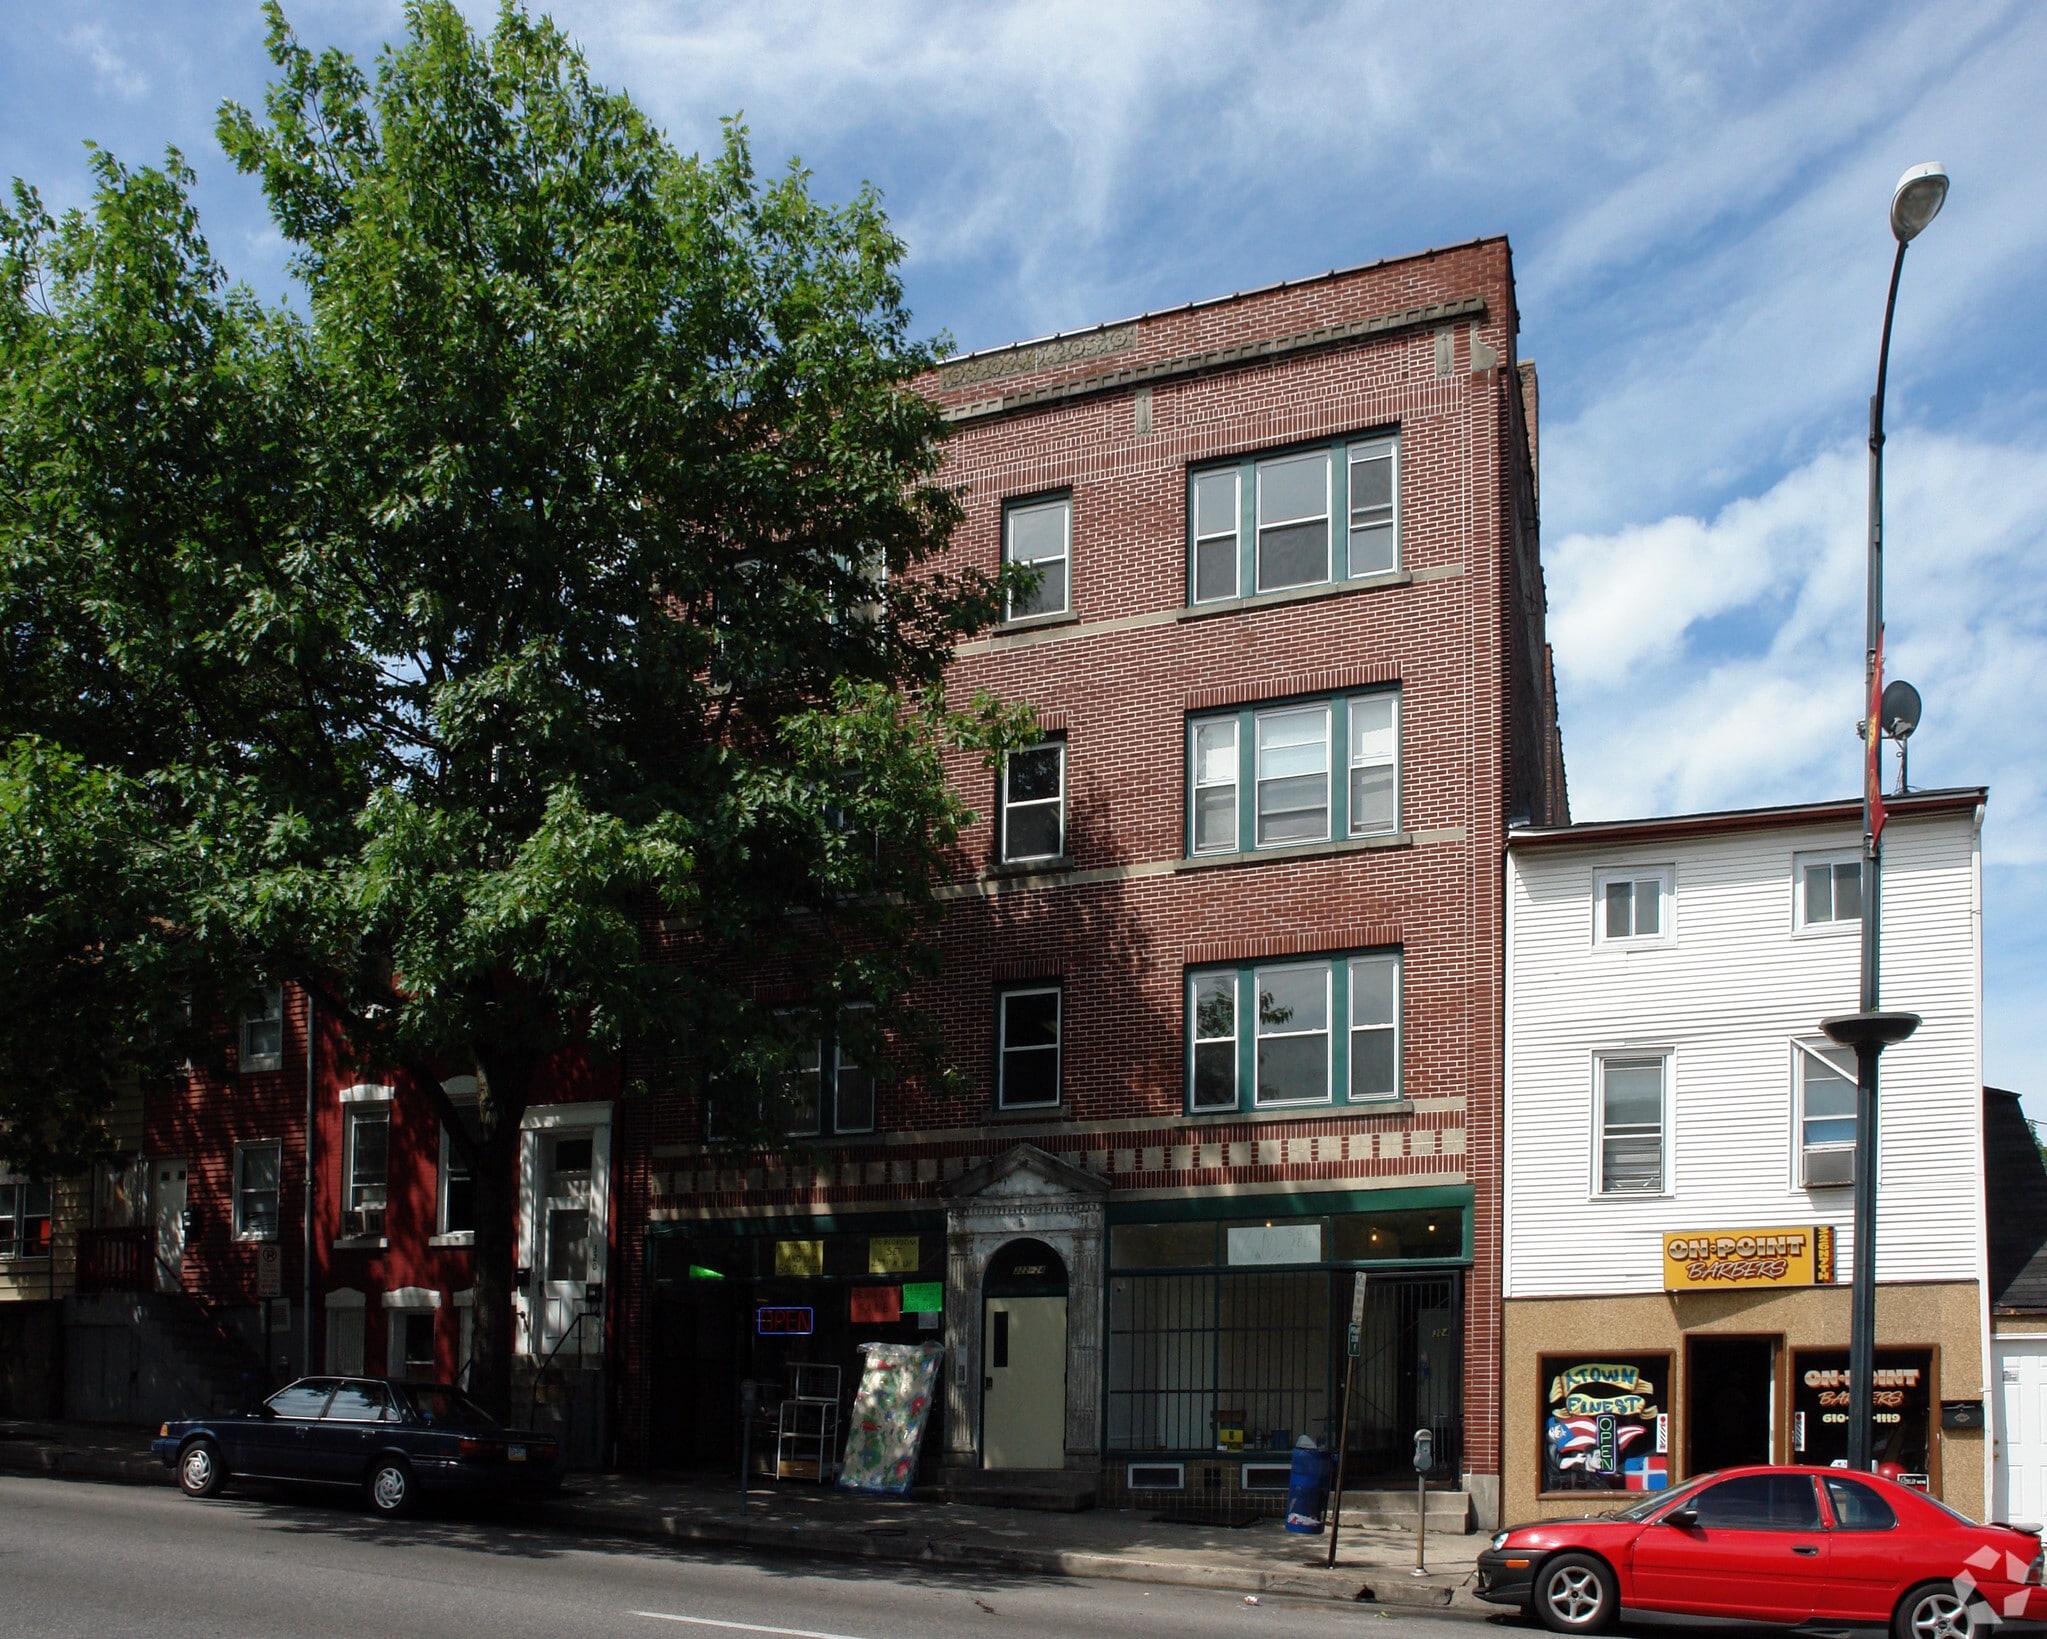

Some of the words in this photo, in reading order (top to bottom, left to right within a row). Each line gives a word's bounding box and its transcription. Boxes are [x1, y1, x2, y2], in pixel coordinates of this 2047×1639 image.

[1686, 1260, 1787, 1281] BARBERS
[760, 1310, 811, 1331] OPEN
[1567, 1397, 1642, 1414] FINEST
[1599, 1418, 1613, 1470] OPEN
